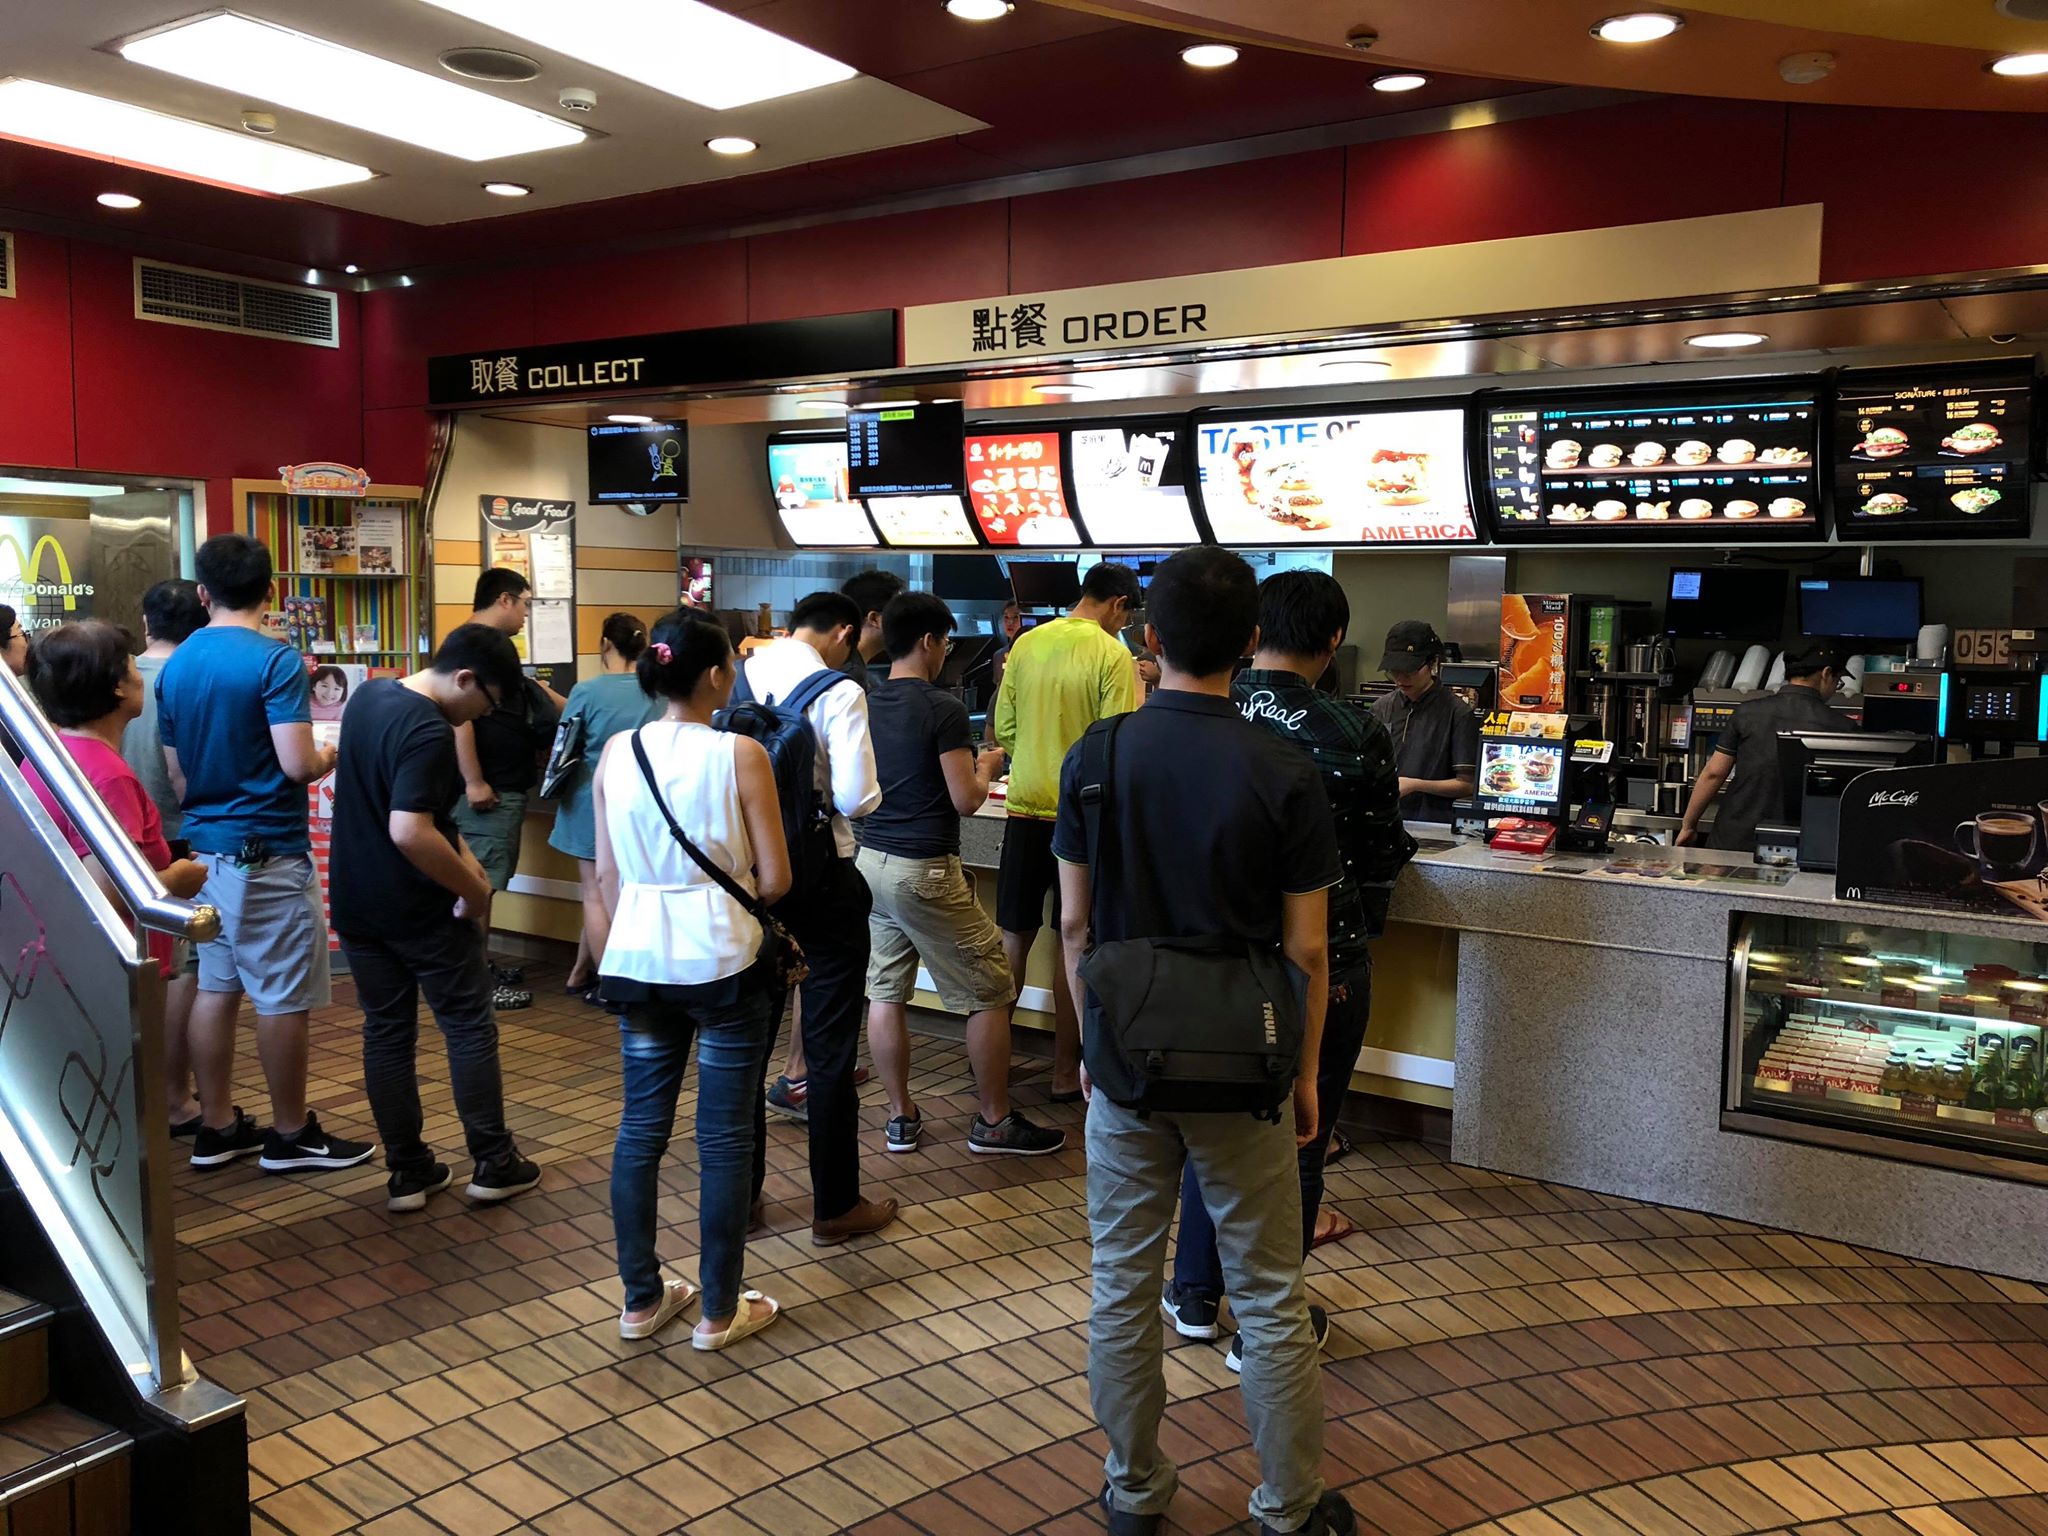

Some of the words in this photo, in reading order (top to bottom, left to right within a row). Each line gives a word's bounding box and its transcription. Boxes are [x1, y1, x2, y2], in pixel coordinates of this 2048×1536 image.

[972, 302, 1047, 352] 點餐
[1063, 303, 1208, 344] ORDER
[470, 356, 519, 393] 取餐
[528, 358, 645, 389] COLLECT
[1894, 386, 1936, 400] SIGNATURE
[511, 501, 543, 516] Good
[542, 504, 572, 517] Food
[1361, 523, 1477, 541] AMERICA
[1524, 788, 1558, 798] AMERICA
[1262, 1001, 1277, 1044] THULE
